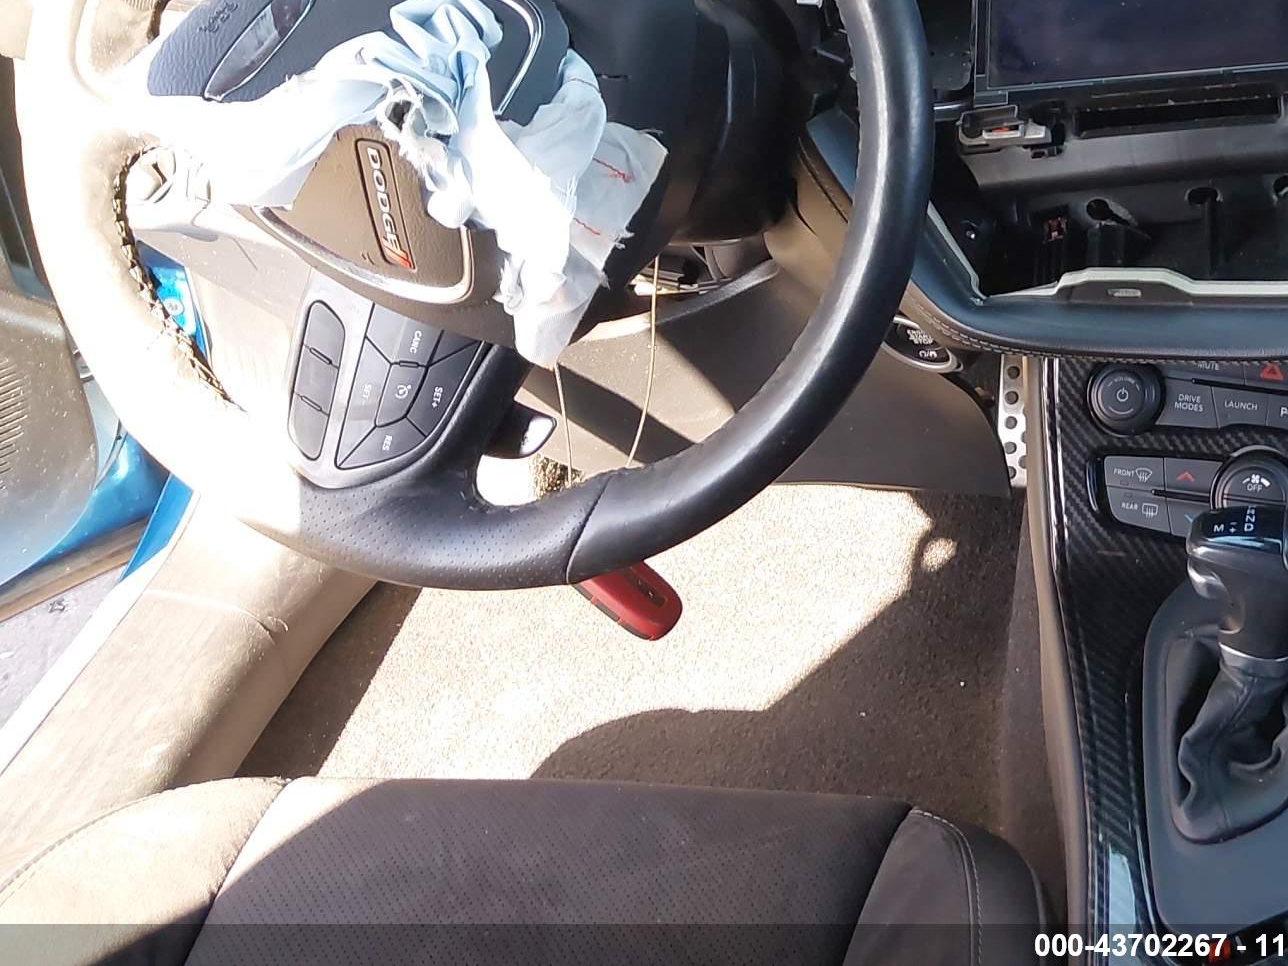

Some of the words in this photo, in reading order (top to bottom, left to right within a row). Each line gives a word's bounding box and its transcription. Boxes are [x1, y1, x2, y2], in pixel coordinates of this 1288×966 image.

[366, 146, 403, 251] DODGE
[431, 386, 443, 409] SET+
[1178, 393, 1201, 403] DRIVE
[1174, 401, 1204, 412] MODES
[1224, 400, 1258, 411] LAUNCH
[382, 434, 393, 451] RES
[1113, 468, 1135, 478] FRONT
[1246, 484, 1262, 492] OFF
[1245, 515, 1256, 523] N
[1213, 524, 1224, 533] M
[1243, 523, 1254, 532] D
